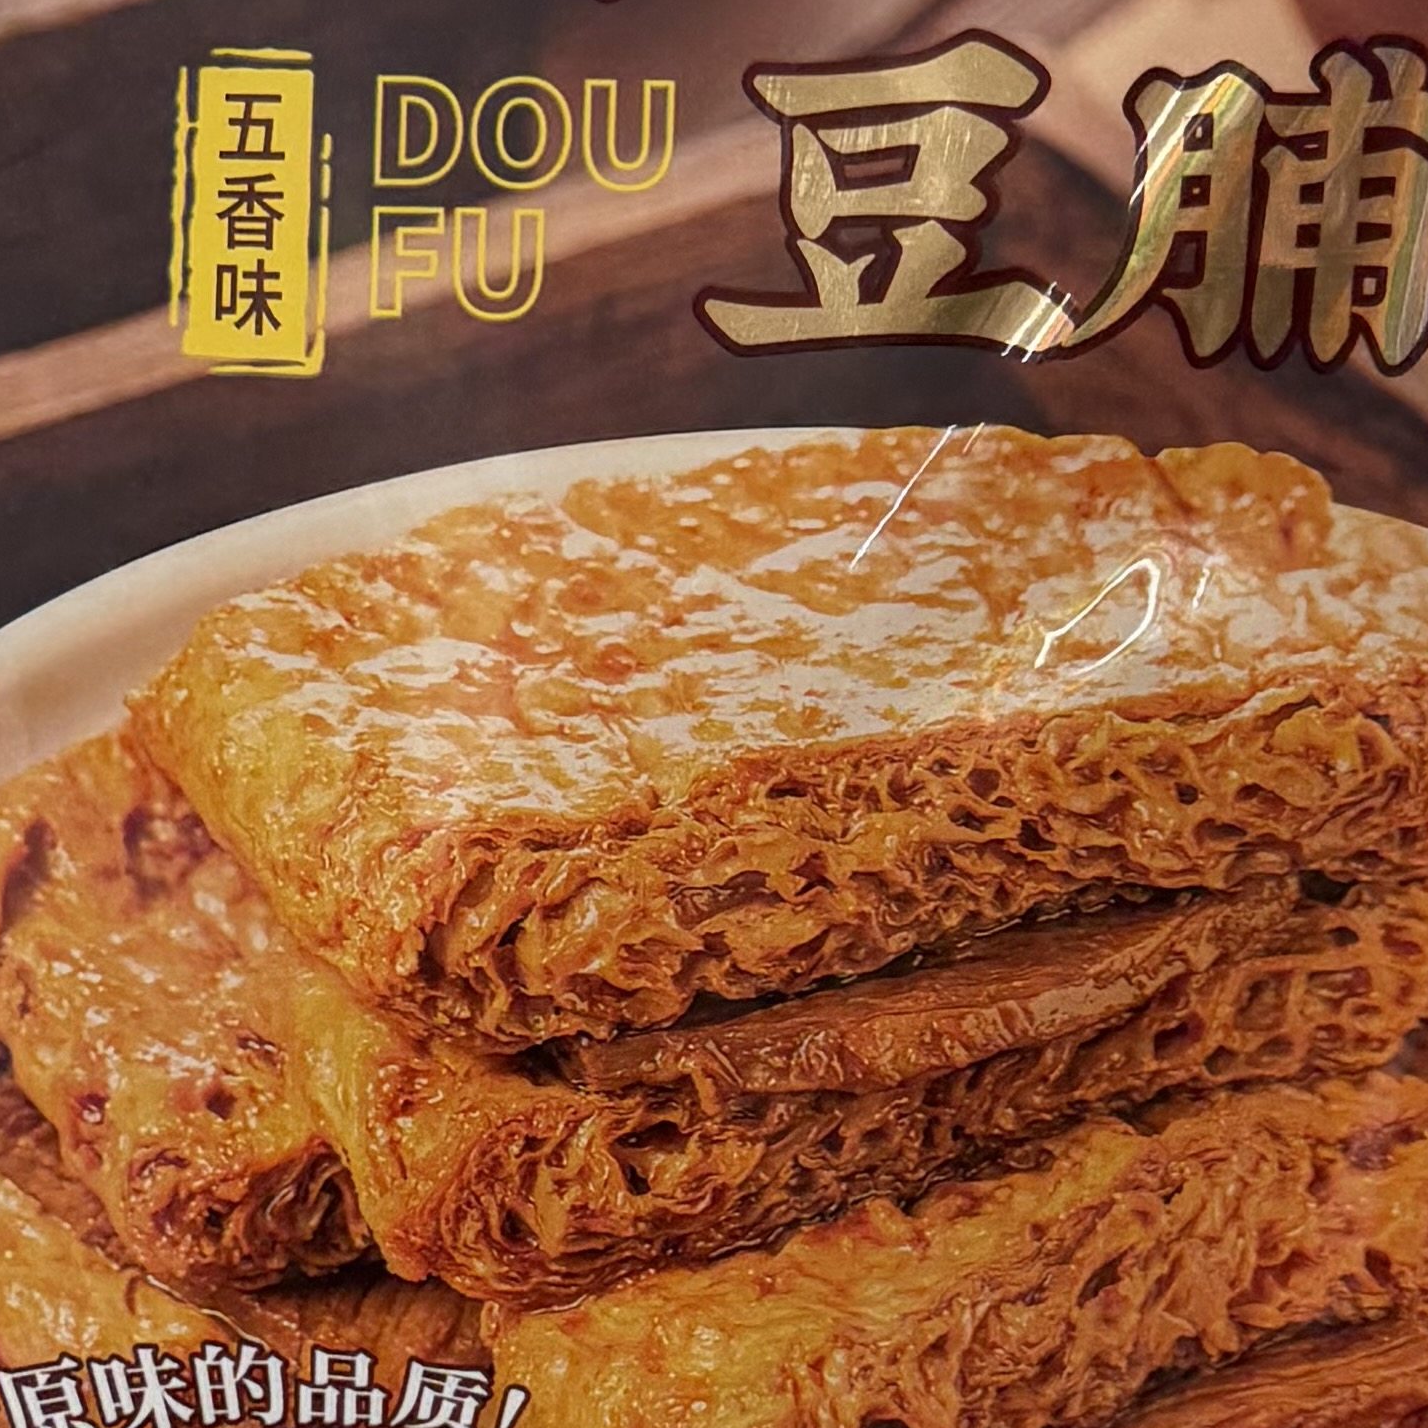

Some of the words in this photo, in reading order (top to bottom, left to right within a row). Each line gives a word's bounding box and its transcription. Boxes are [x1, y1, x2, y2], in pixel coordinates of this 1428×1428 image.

[372, 74, 677, 192] DOU
[213, 92, 286, 336] 五香味
[371, 206, 546, 322] FU
